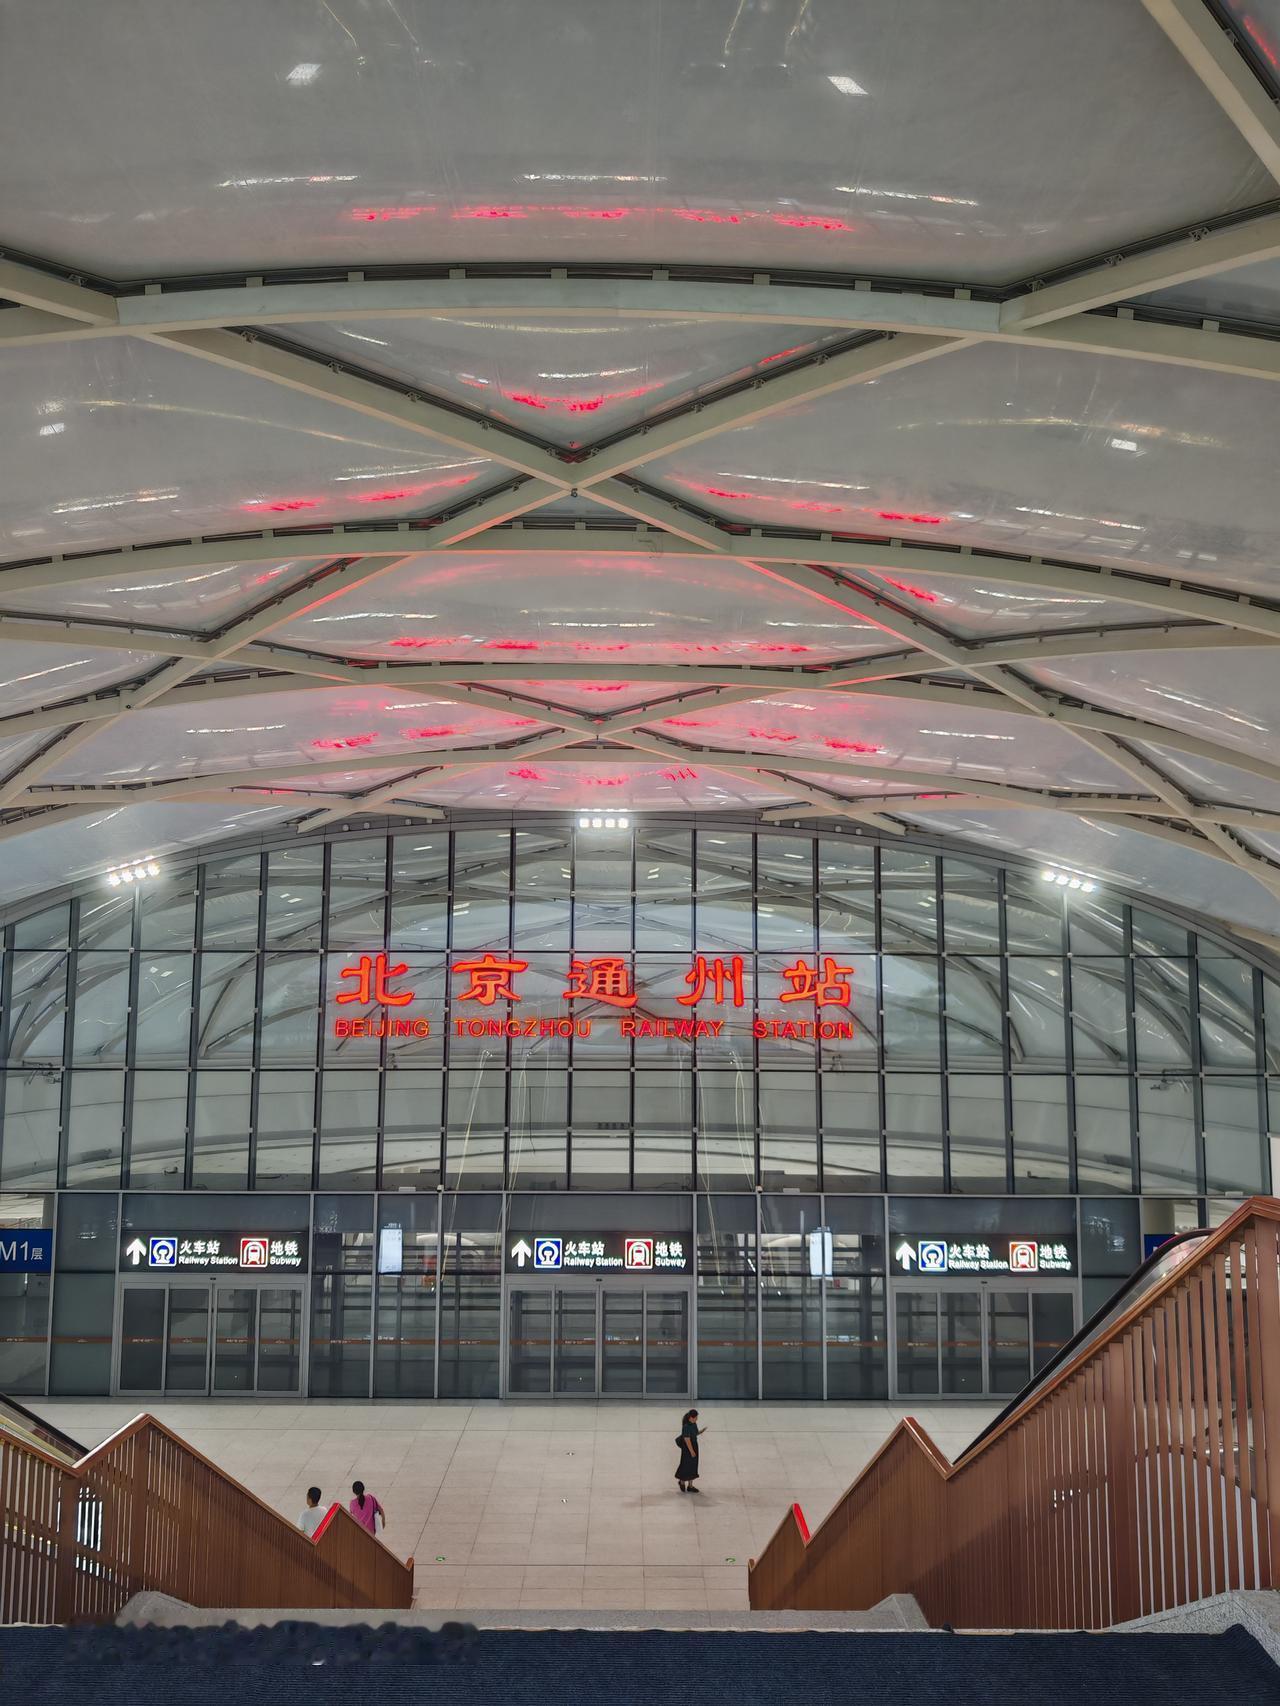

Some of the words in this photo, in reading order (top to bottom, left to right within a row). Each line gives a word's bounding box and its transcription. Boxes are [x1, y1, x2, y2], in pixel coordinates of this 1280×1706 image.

[336, 953, 854, 1007] 北京通州站
[335, 1019, 430, 1038] BEIJING
[453, 1019, 591, 1038] TONGZHOU
[621, 1020, 724, 1038] RAILWAY
[753, 1020, 854, 1038] STATION
[180, 1240, 221, 1255] 火车站
[270, 1240, 299, 1256] 地铁
[565, 1241, 605, 1256] 火车站
[655, 1241, 683, 1257] 地铁
[949, 1244, 990, 1259] 火车站
[1039, 1244, 1068, 1260] 地铁
[178, 1256, 209, 1266] Railway
[210, 1256, 238, 1266] Station
[270, 1257, 301, 1267] Subway
[564, 1257, 594, 1267] Railway
[595, 1257, 623, 1266] Station
[655, 1258, 686, 1268] Subway
[949, 1260, 980, 1271] Railway
[980, 1260, 1009, 1270] Station
[1039, 1260, 1072, 1271] Subway
